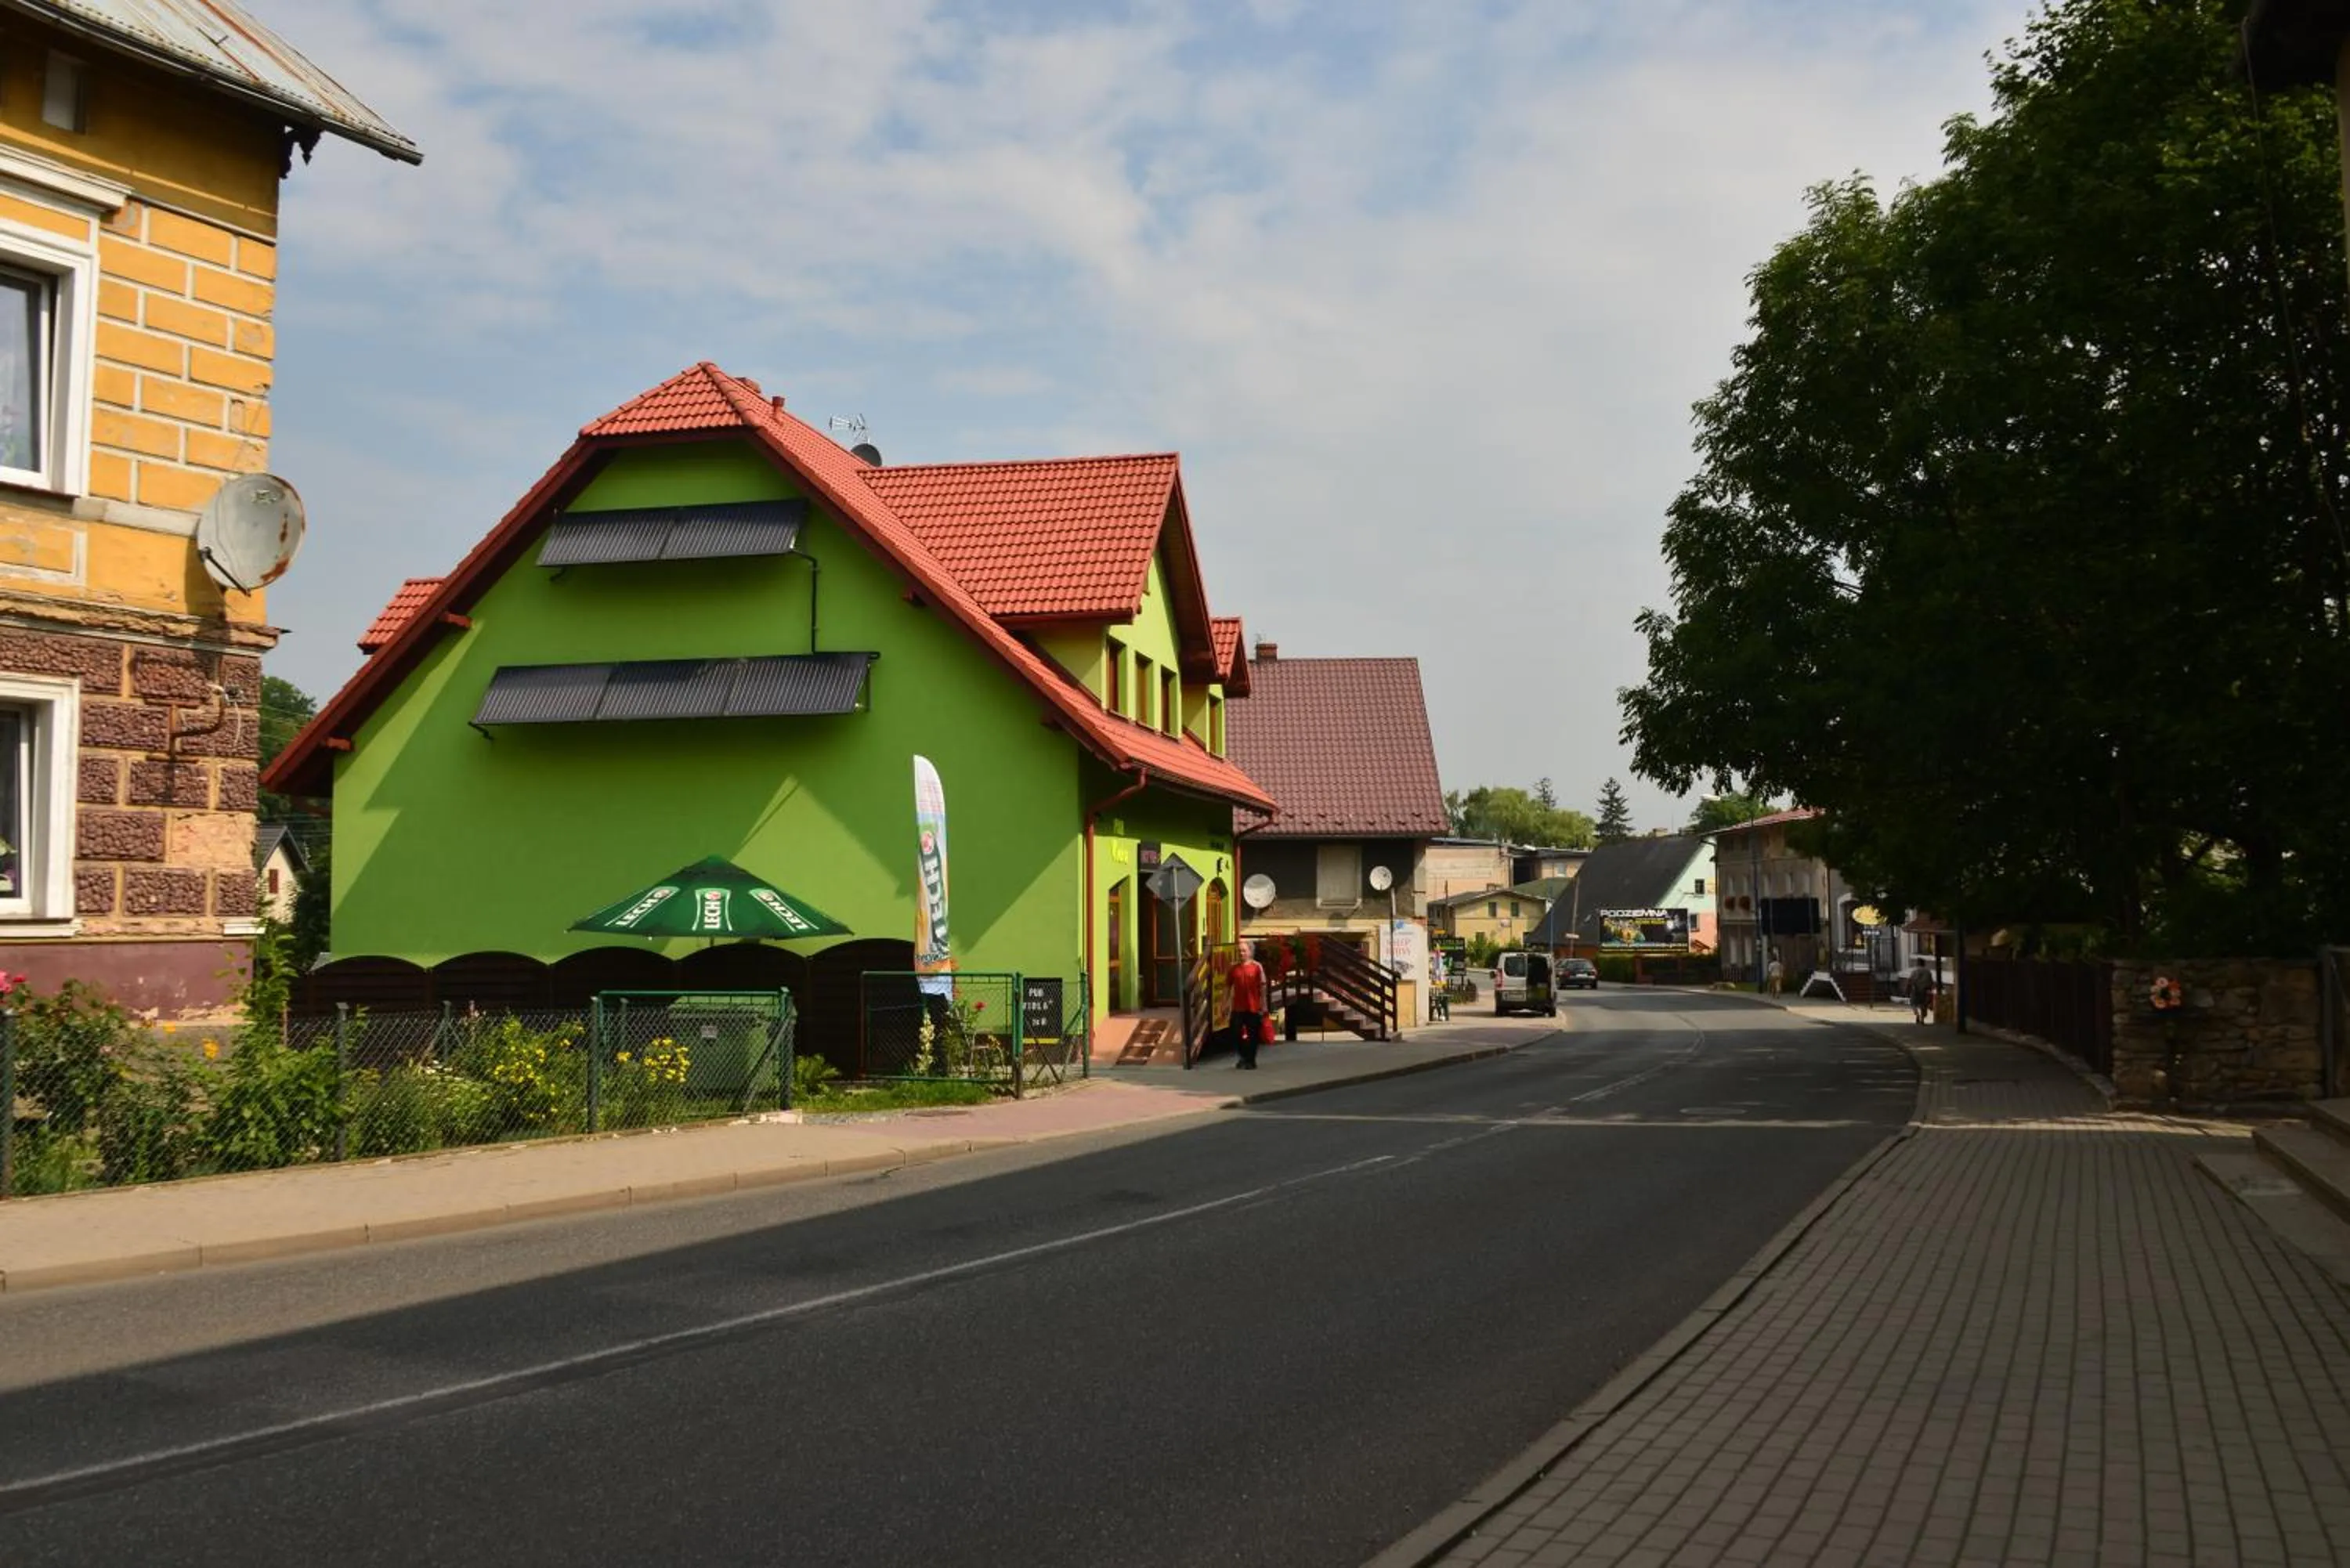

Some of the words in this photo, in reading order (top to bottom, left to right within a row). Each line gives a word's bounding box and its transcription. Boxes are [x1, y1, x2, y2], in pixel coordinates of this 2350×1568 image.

[615, 898, 660, 926] LECH
[704, 900, 721, 929] LECH
[768, 901, 809, 930] LECH
